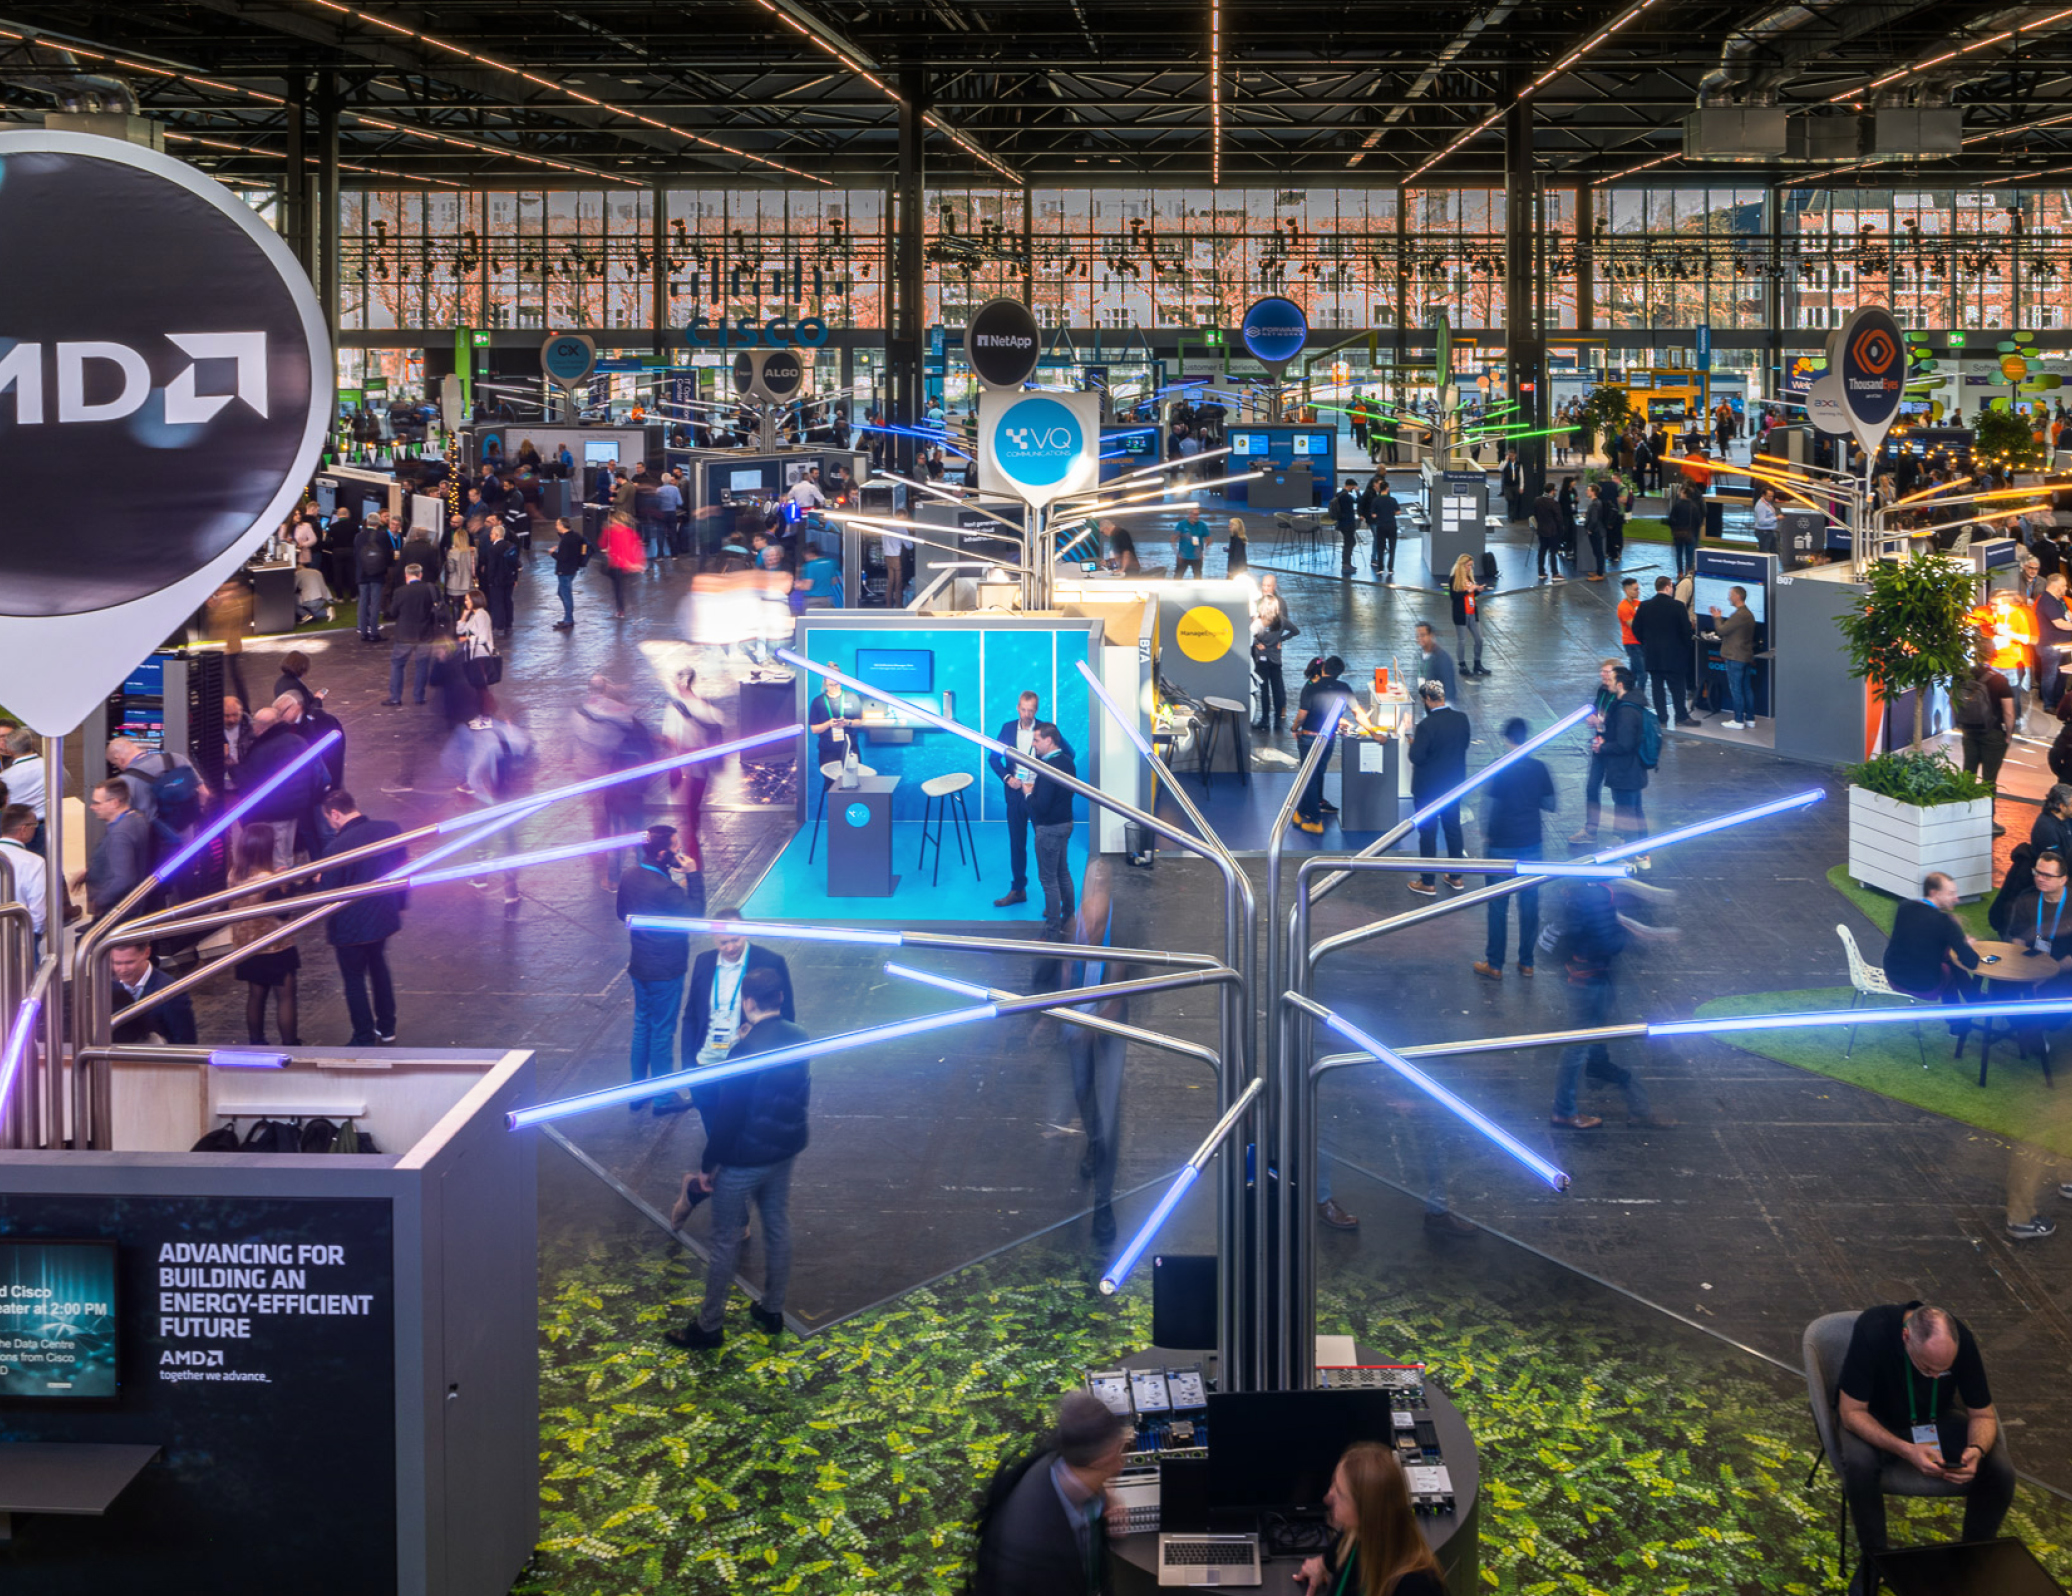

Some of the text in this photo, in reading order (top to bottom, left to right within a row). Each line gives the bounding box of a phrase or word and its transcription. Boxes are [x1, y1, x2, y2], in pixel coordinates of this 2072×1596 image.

[685, 317, 829, 347] CISCO
[990, 334, 1032, 348] NetApp
[557, 344, 580, 357] CX
[764, 368, 799, 378] ALGO
[1218, 363, 1263, 373] Eperience
[1849, 377, 1898, 393] ThousandEyes
[1031, 427, 1072, 449] VQ
[1776, 575, 1794, 585] B07
[1139, 639, 1151, 664] B7A
[158, 1243, 345, 1266] ADVANCING FOR
[159, 1267, 306, 1290] BUILDING AN
[11, 1285, 52, 1298] Cisco
[33, 1302, 47, 1315] at
[50, 1303, 81, 1316] 2:00
[84, 1303, 107, 1316] PM
[159, 1292, 373, 1315] ENERGY-EFFICIENT
[159, 1317, 251, 1339] FUTURE
[14, 1339, 38, 1349] Data
[40, 1339, 75, 1350] Centre
[20, 1352, 43, 1362] from
[45, 1352, 75, 1363] Cisco
[159, 1350, 206, 1366] AMD
[159, 1370, 272, 1383] together we advance_
